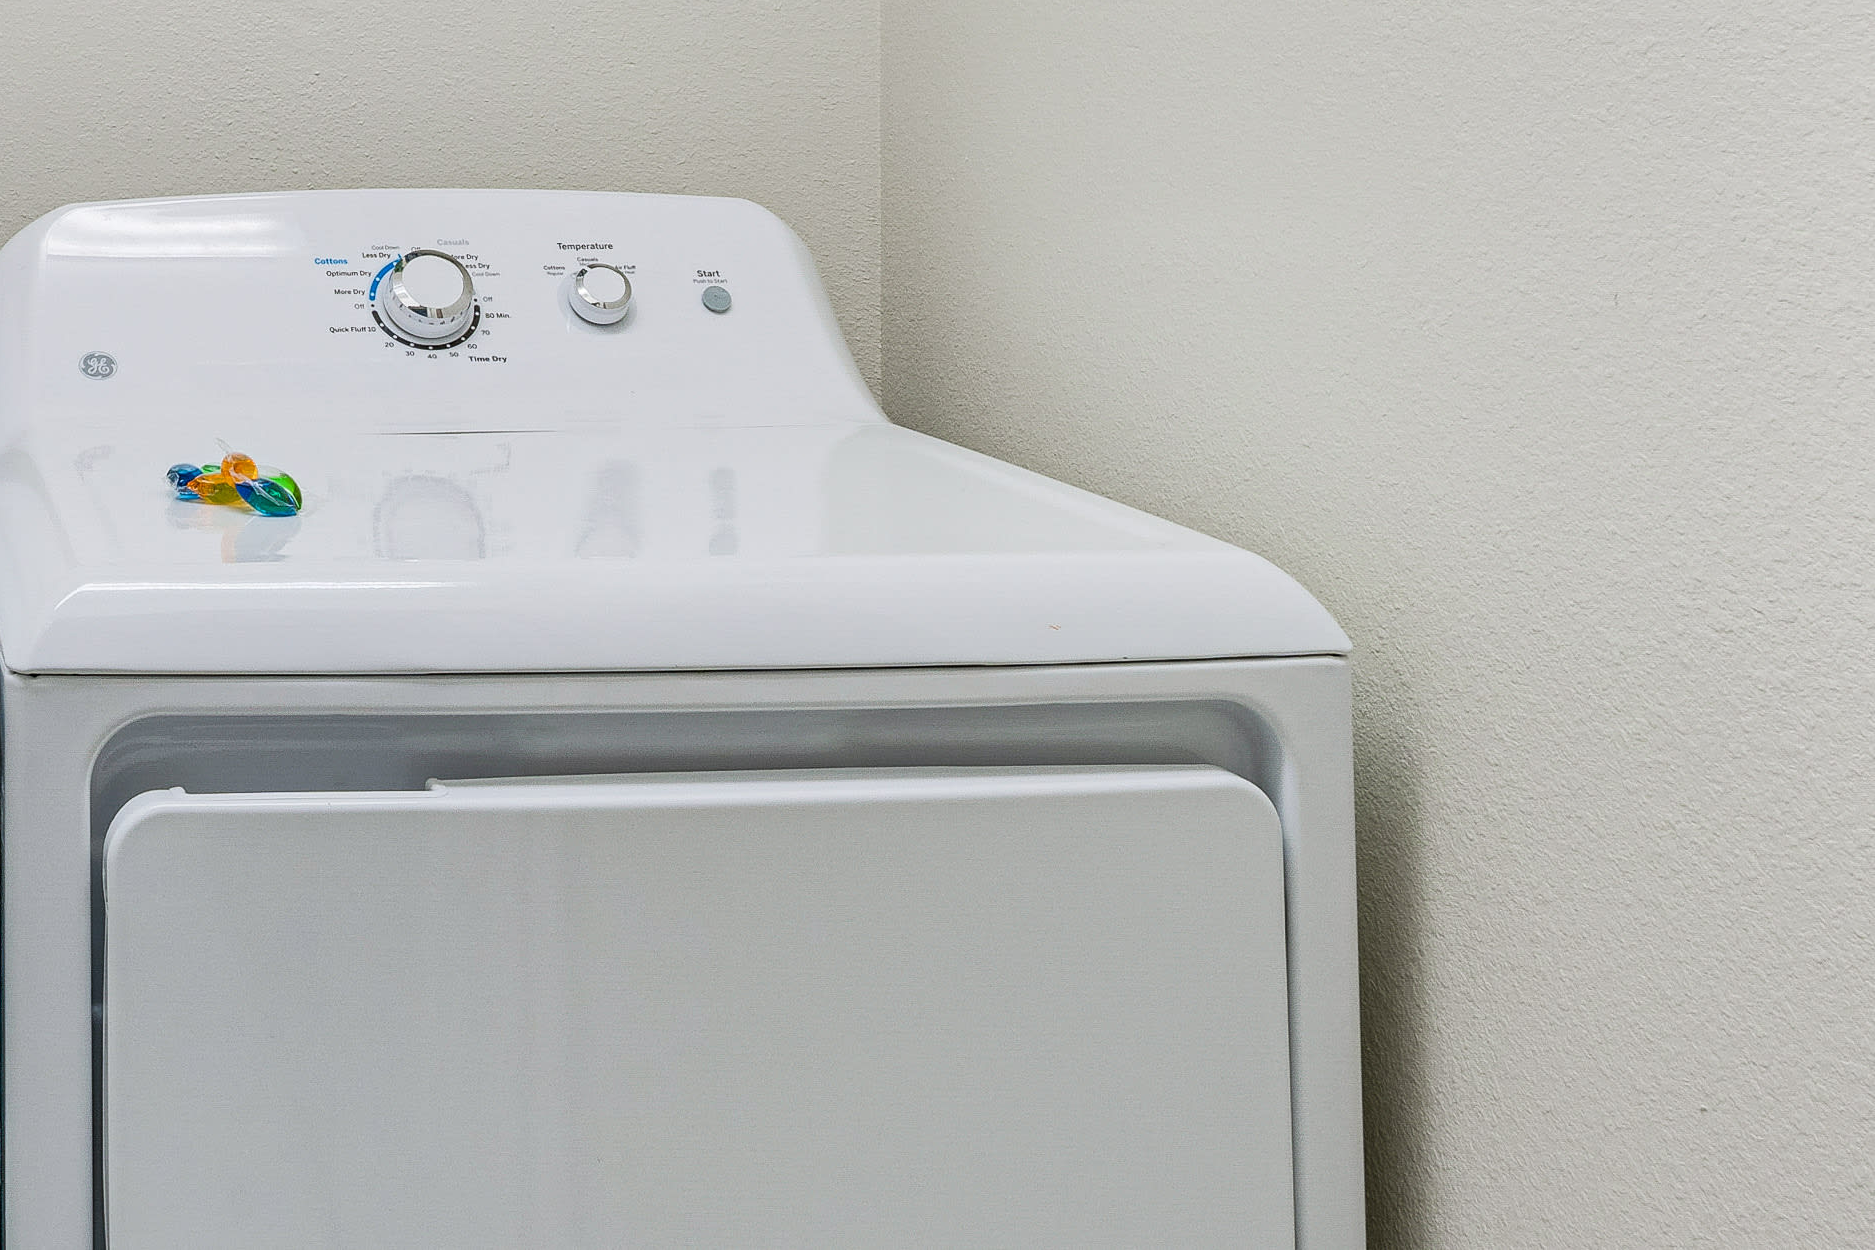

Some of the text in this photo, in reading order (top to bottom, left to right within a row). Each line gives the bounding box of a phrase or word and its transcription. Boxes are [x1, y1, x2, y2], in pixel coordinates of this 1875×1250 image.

[556, 242, 614, 251] Temperature
[314, 257, 348, 265] Cottons
[325, 270, 372, 278] Optimum Dry
[696, 269, 721, 278] Start
[352, 288, 366, 296] Dry
[468, 355, 508, 364] Time Dry
